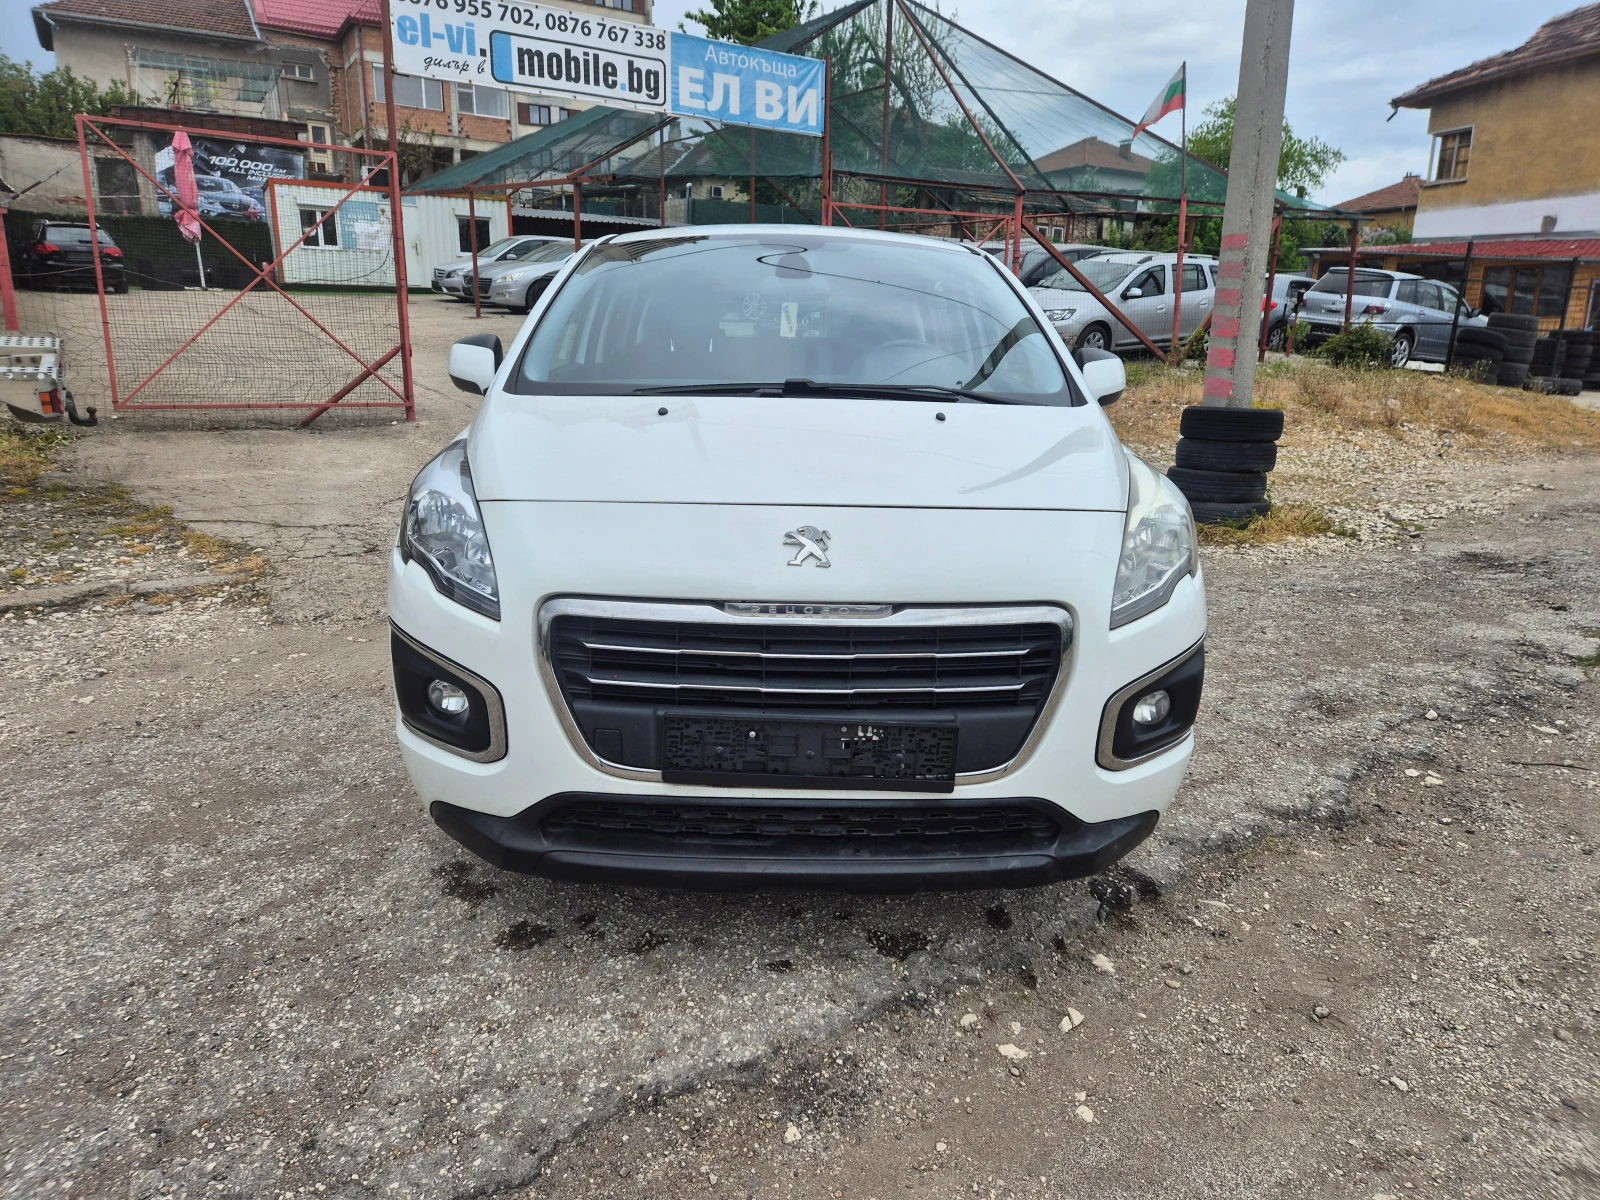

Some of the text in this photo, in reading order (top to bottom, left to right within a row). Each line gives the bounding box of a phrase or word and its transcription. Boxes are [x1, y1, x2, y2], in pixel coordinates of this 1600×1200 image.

[454, 0, 492, 18] 955
[497, 4, 540, 30] 702,
[545, 12, 592, 36] 0876
[596, 22, 629, 44] 767
[634, 30, 666, 51] 338
[424, 56, 470, 75] дилър
[517, 46, 660, 100] mobile.bg
[704, 44, 797, 79] Автокъща
[678, 65, 818, 127] ЕЛ ВИ
[209, 155, 238, 167] 100
[239, 159, 274, 172] 000
[228, 166, 247, 175] ALL
[750, 605, 867, 615] PEUGEOT
